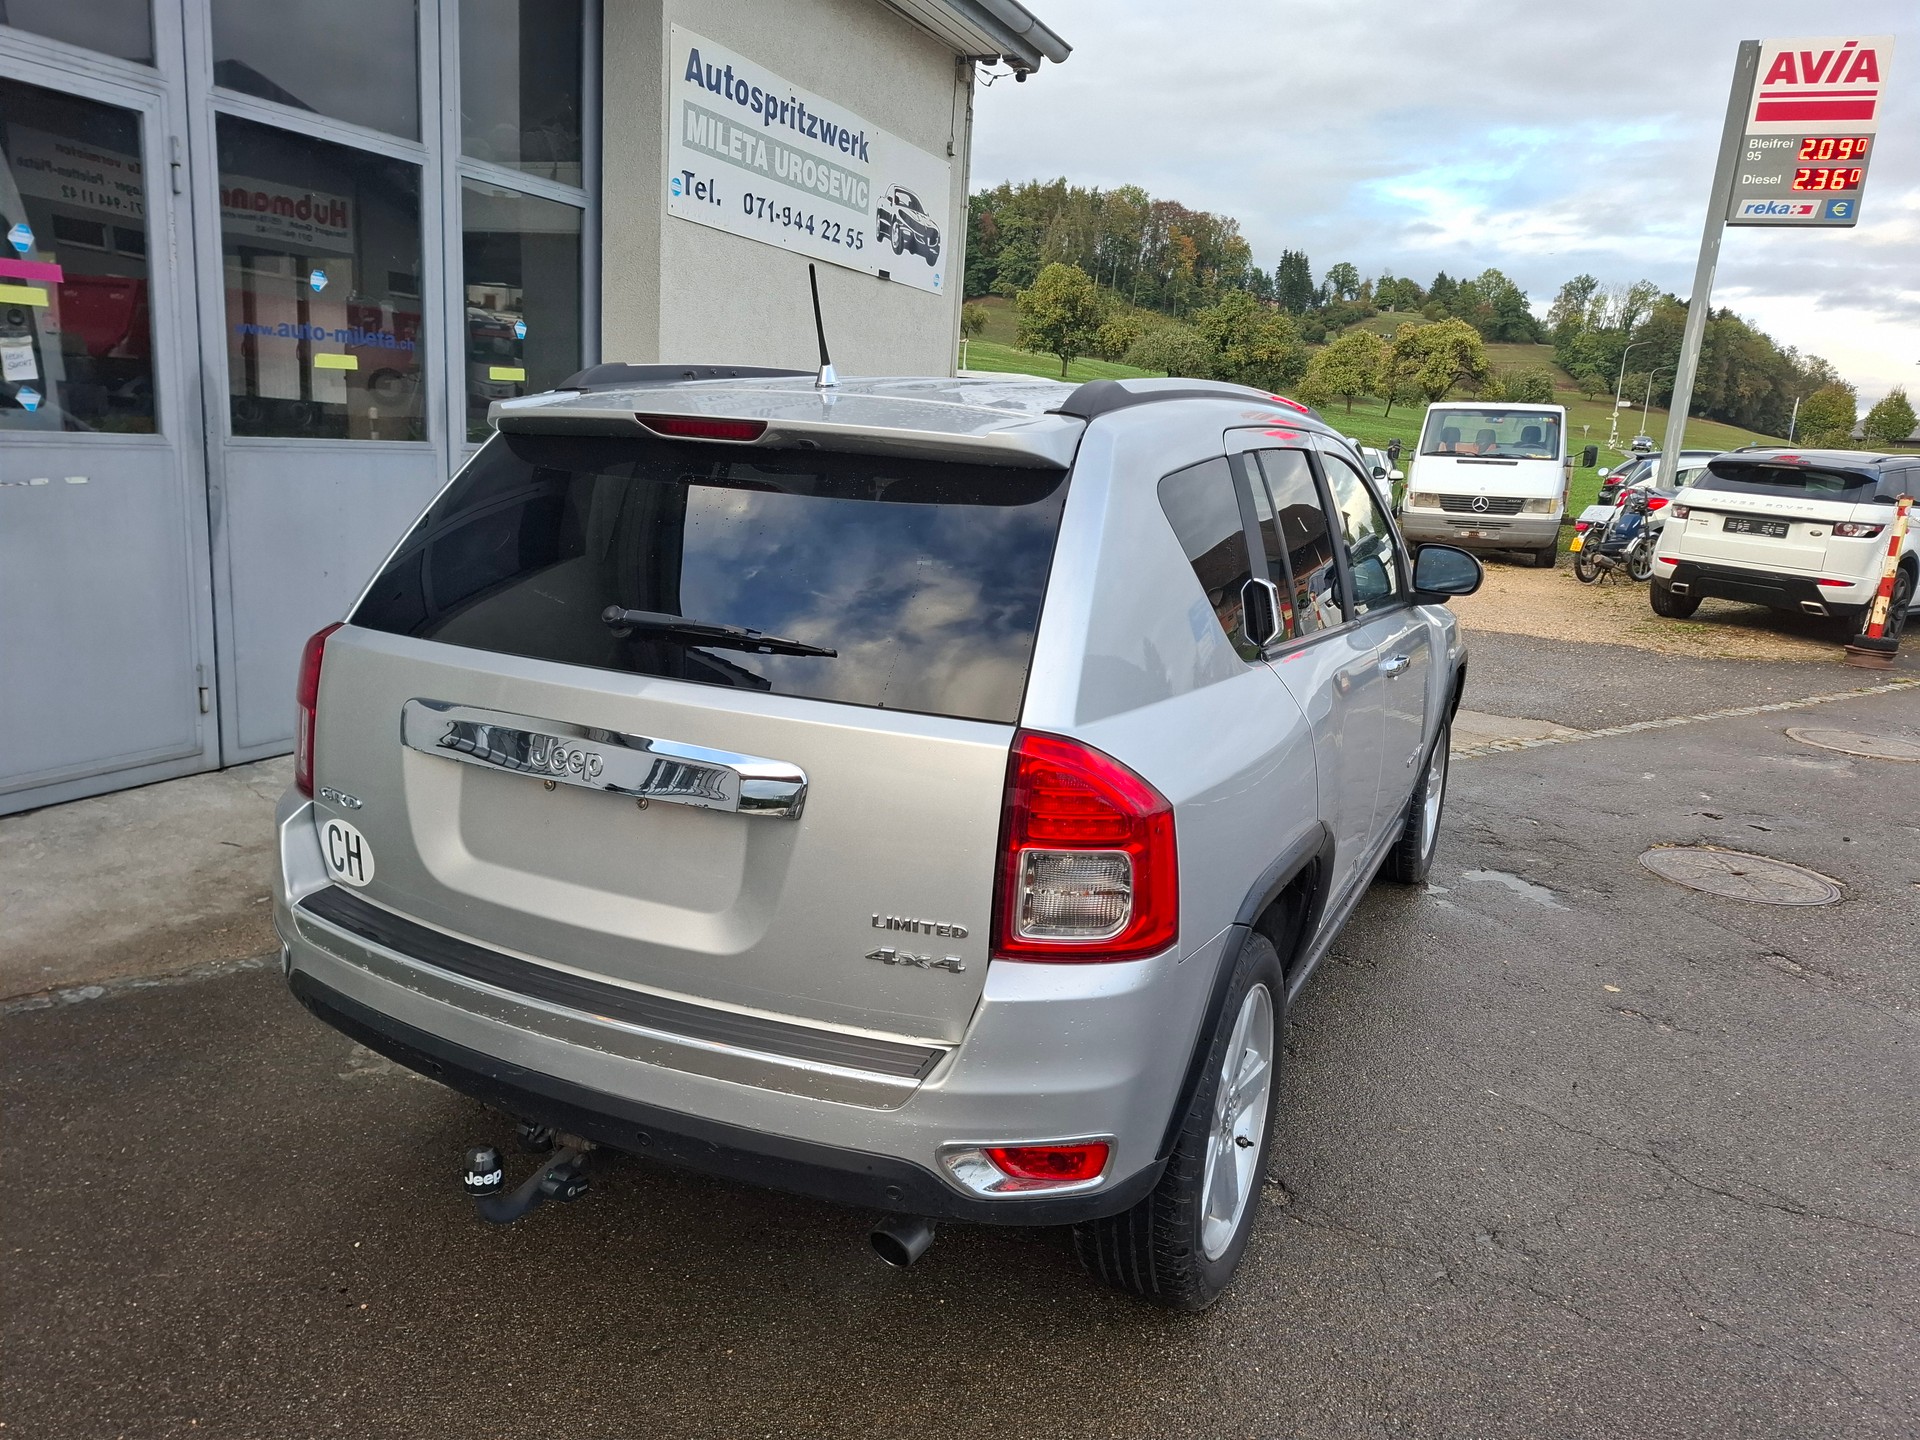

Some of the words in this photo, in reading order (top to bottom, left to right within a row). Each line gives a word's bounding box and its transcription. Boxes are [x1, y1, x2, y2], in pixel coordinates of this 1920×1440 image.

[1762, 41, 1880, 85] AVIA
[684, 48, 869, 163] Autospritzwerk
[687, 110, 769, 171] MILETA
[774, 149, 869, 209] UROSEVIC
[1746, 151, 1762, 161] 95
[1749, 138, 1794, 149] Bleifrei
[1742, 174, 1781, 184] Diesel
[682, 169, 721, 206] Tel.
[743, 193, 815, 236] 071-944
[821, 219, 841, 244] 22
[845, 228, 864, 250] 55
[235, 322, 416, 351] www.auto-mileta.ch
[530, 735, 604, 781] Jeep
[328, 824, 364, 881] CH
[871, 912, 969, 939] LIMITED
[464, 1168, 502, 1186] Jeep
